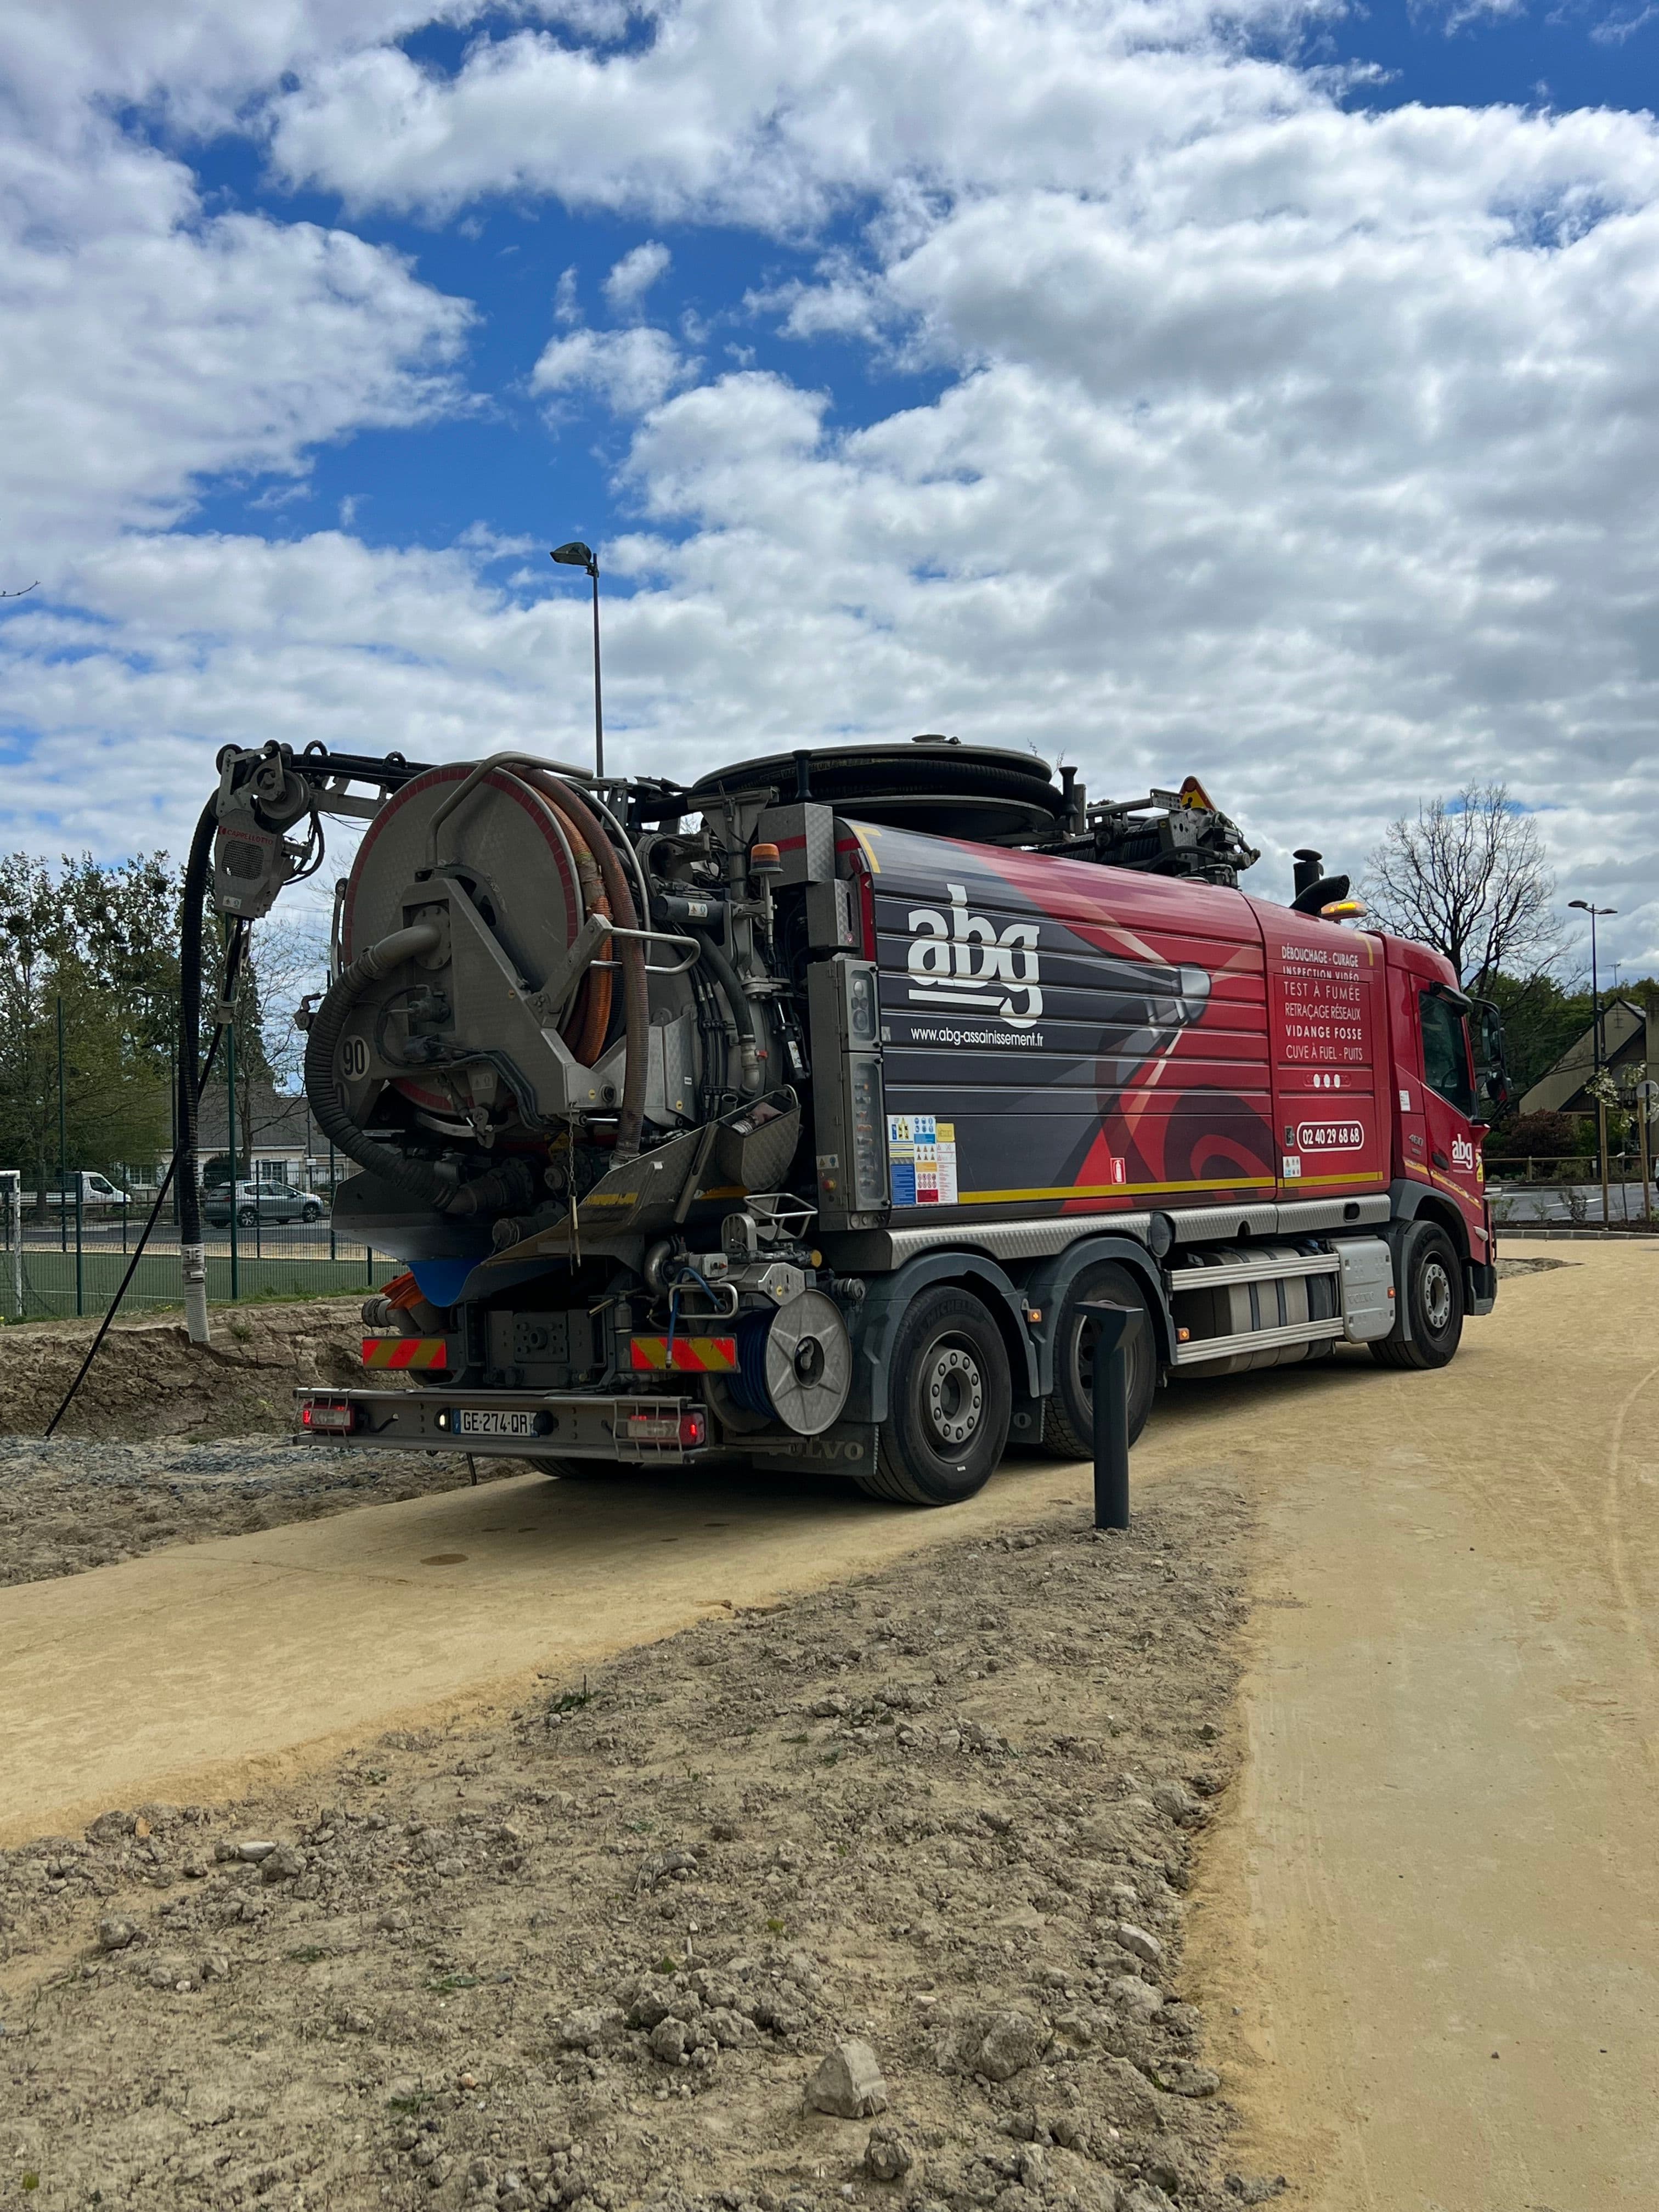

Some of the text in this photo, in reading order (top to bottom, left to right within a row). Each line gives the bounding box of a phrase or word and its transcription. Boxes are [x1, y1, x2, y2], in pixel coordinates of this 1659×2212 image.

[228, 829, 273, 845] CAPPELLOTTO
[908, 883, 1043, 1029] abg
[1282, 943, 1328, 964] DÉBOUCHAGE
[1333, 952, 1359, 967] CURAGE
[1283, 966, 1359, 981] INSPECTION VIDÉO
[1284, 980, 1361, 1001] TEST À FUMÉE
[1285, 1002, 1361, 1021] RETRAÇAGE RÉSEAUX
[911, 1027, 1043, 1047] www.abg-assainissement.fr
[1285, 1024, 1362, 1040] VIDANGE FOSSE
[343, 1040, 364, 1075] 90
[1285, 1044, 1309, 1059] CUVE
[1311, 1042, 1319, 1059] À
[1319, 1046, 1337, 1060] FUEL
[1344, 1047, 1363, 1060] PUITS
[1302, 1127, 1359, 1145] 02 40 29 68 68
[1452, 1133, 1474, 1170] abg
[464, 1412, 528, 1434] GE-274-QR
[770, 1435, 865, 1460] OLVO
